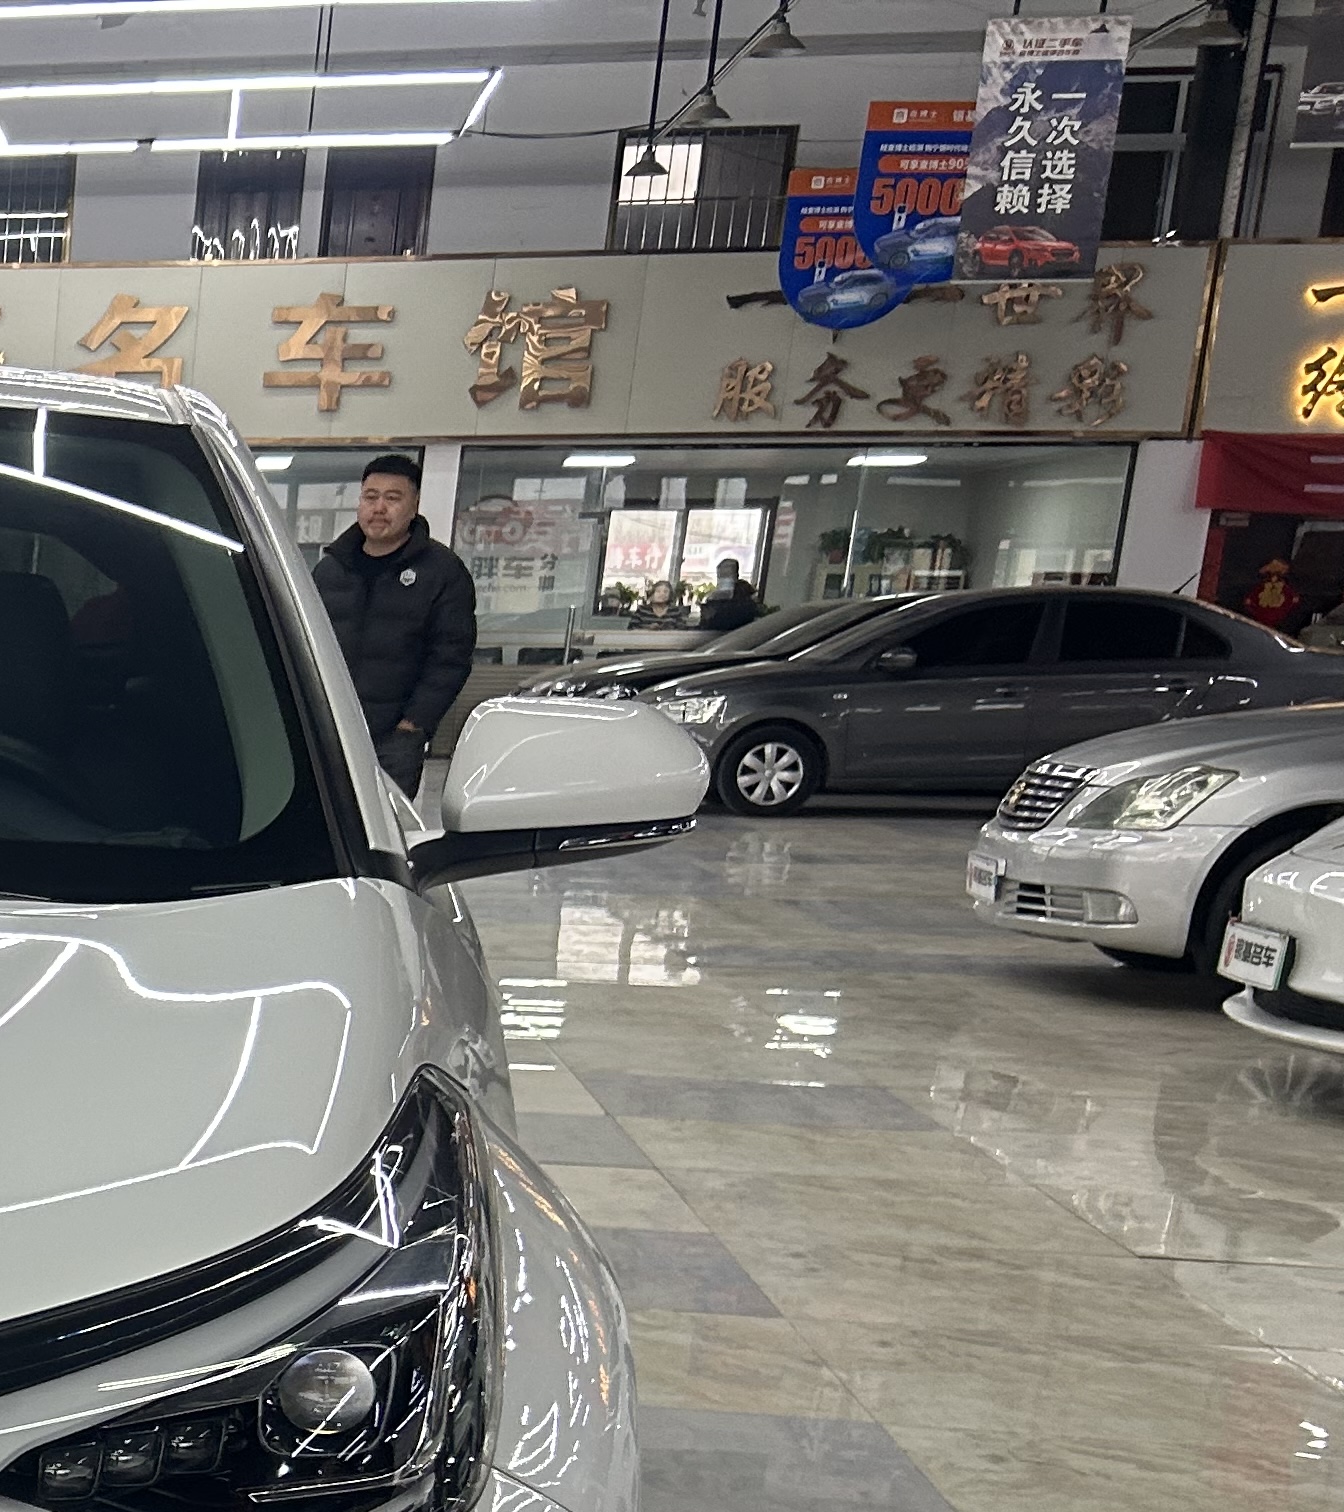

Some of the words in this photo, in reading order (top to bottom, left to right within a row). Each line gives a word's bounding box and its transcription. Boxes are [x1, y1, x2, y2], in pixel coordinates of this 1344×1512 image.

[870, 177, 964, 216] 5000
[994, 82, 1044, 215] 永久信赖
[1036, 91, 1087, 214] 一次选择
[726, 263, 1153, 346] 一一世界
